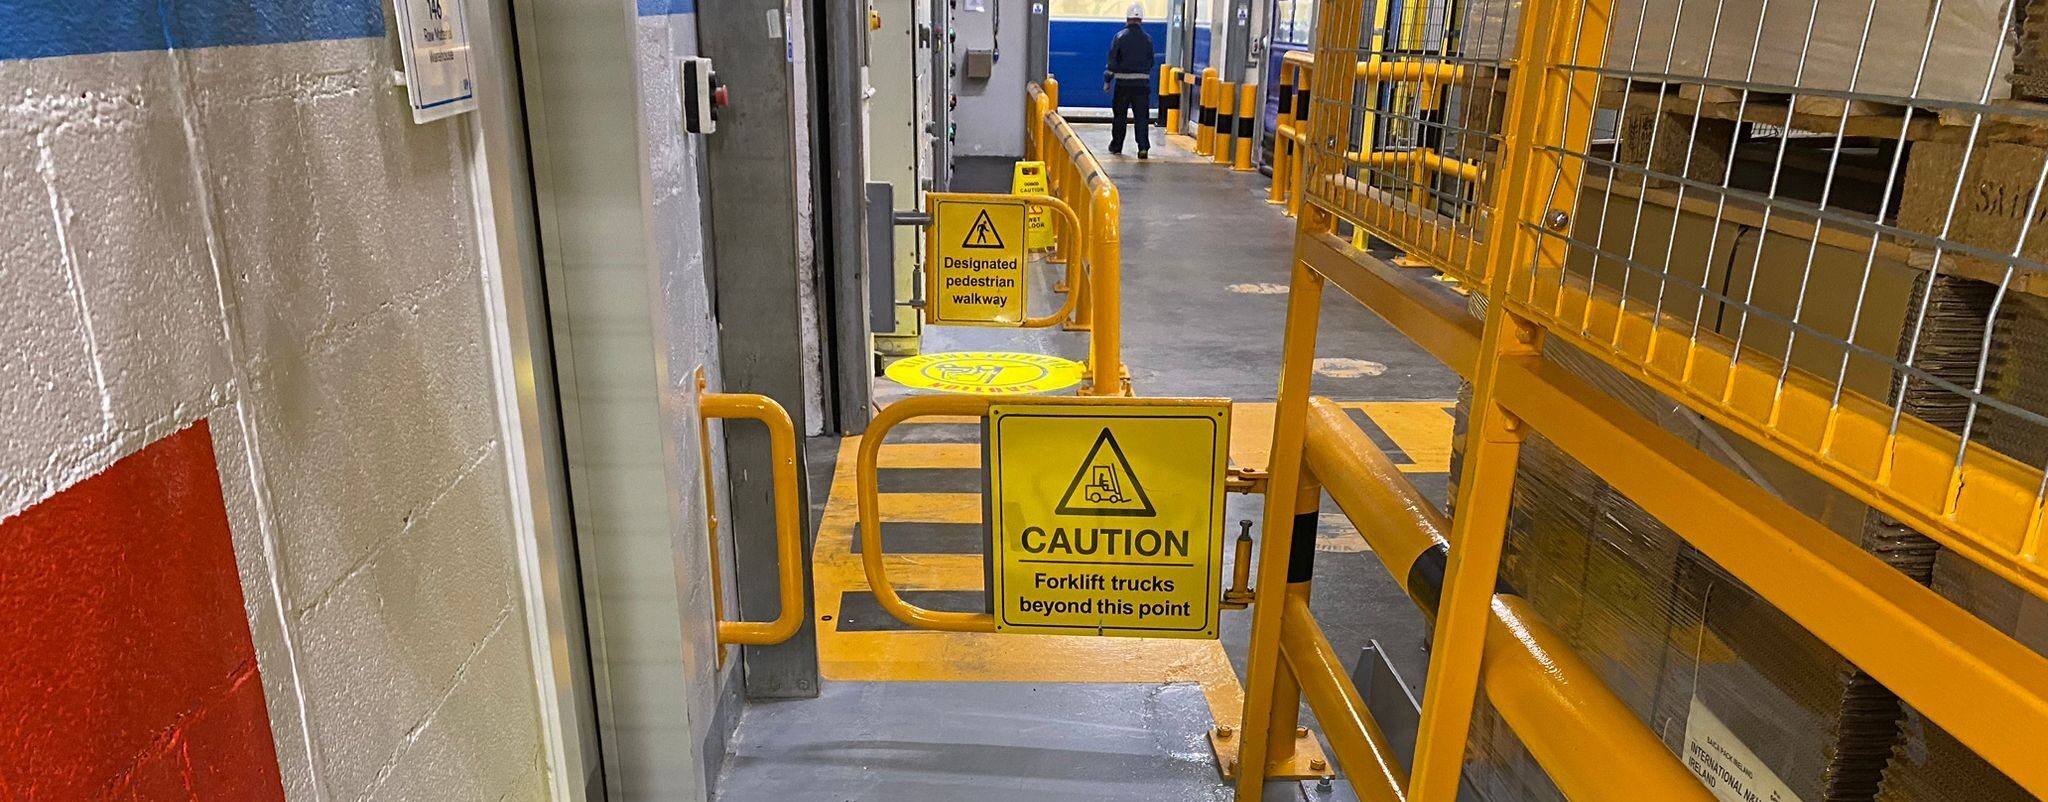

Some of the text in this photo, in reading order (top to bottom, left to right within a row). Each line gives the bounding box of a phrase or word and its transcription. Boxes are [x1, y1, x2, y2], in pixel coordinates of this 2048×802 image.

[944, 256, 1017, 272] Designated
[946, 275, 1015, 289] pedestrian
[952, 293, 1008, 308] walkway
[1021, 526, 1189, 557] CAUTION
[1034, 572, 1175, 592] Forklift trucks
[1019, 596, 1190, 619] beyond this point
[1688, 756, 1716, 788] IRELAND
[1690, 741, 1742, 796] INTERNATIONAL
